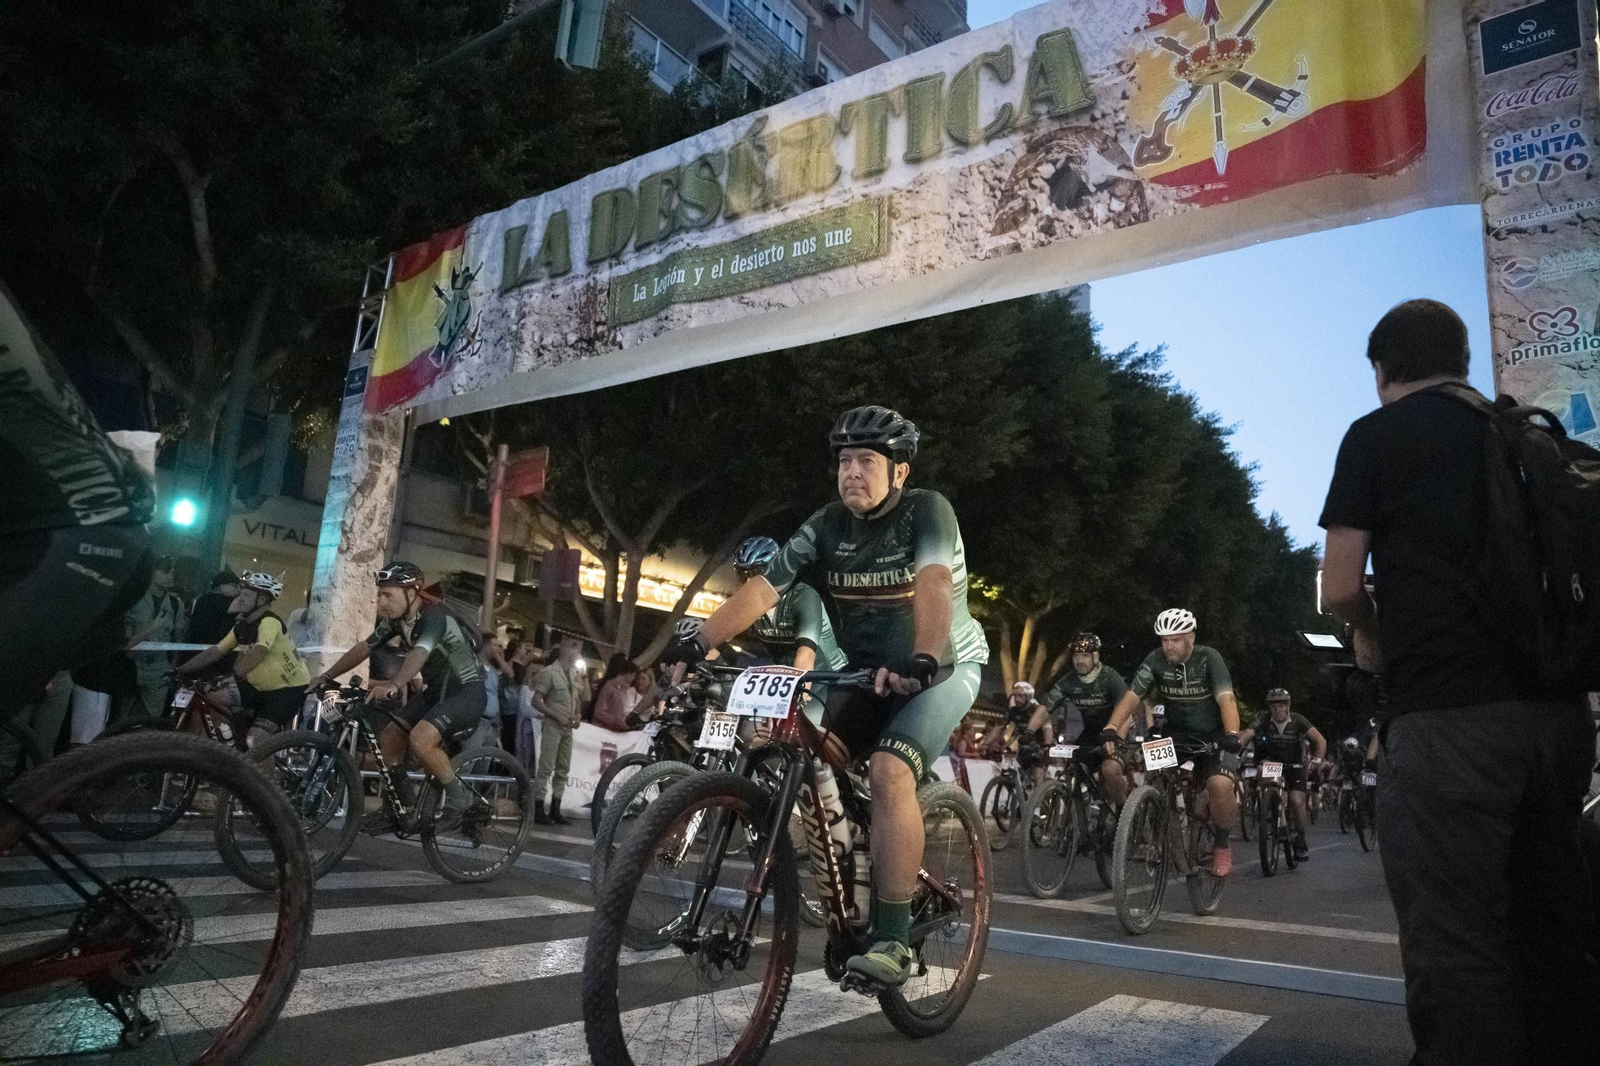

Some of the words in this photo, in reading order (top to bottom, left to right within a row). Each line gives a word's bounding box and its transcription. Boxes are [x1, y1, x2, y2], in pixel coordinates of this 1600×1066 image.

[1501, 28, 1556, 52] SENATOR
[1485, 70, 1582, 118] Coca-Cola
[1493, 118, 1582, 148] GRUPO
[503, 209, 571, 294] LA
[587, 26, 1097, 262] DESÉRTICA
[1494, 131, 1588, 168] RENTA
[1496, 152, 1589, 189] TODO
[632, 283, 647, 303] La
[652, 267, 686, 298] Legión
[693, 264, 705, 286] y
[711, 258, 724, 279] el
[730, 243, 785, 275] desierto
[792, 235, 817, 258] nos
[824, 227, 853, 249] une
[827, 570, 840, 587] LA
[843, 566, 910, 587] DESÉRTICA
[743, 674, 796, 698] 5185
[709, 721, 735, 738] 5156
[877, 737, 892, 748] LA
[1150, 746, 1174, 762] 5238
